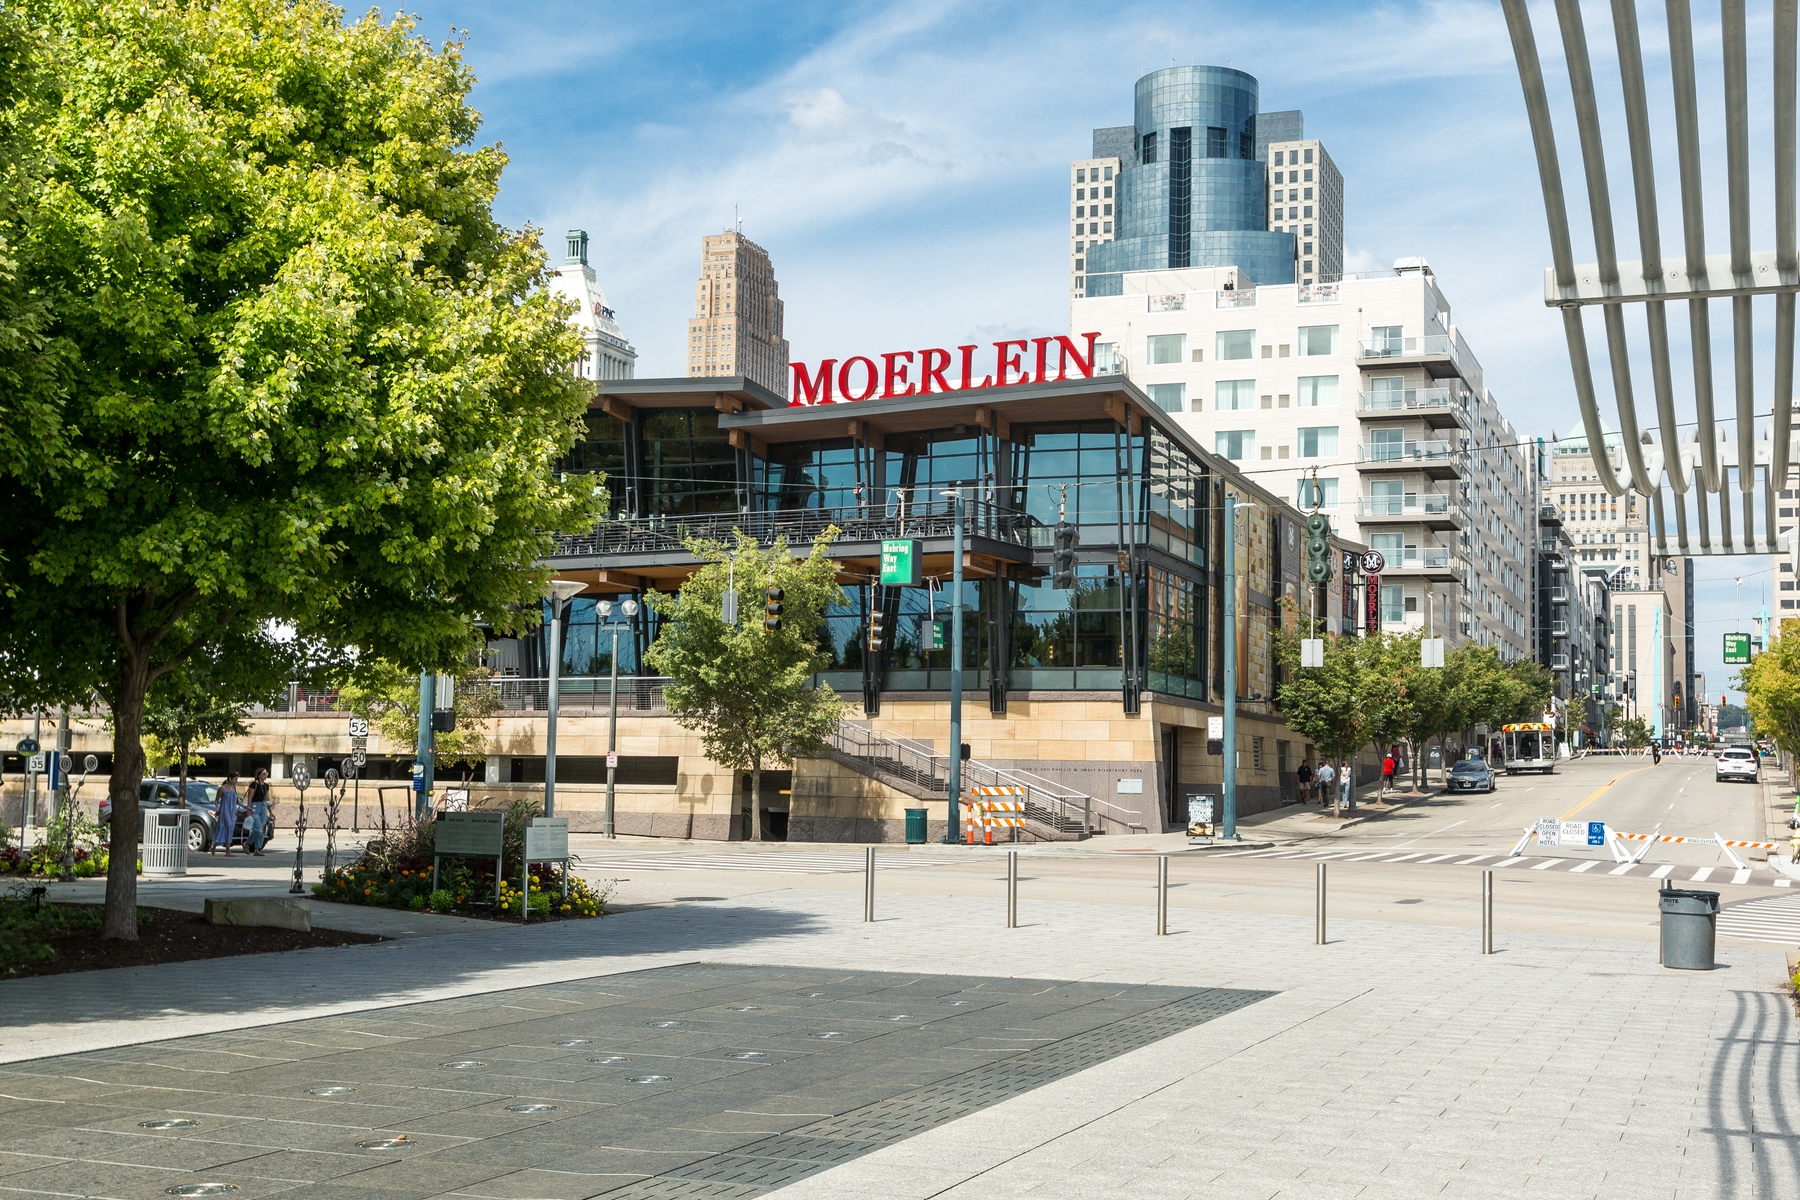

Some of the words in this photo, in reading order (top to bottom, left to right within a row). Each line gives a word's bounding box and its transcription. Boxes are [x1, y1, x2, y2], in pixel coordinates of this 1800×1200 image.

[602, 305, 615, 319] PNC
[787, 331, 1101, 408] MOERLEIN
[883, 543, 908, 554] Mehring
[883, 553, 897, 565] Way
[1364, 554, 1379, 569] M
[882, 563, 896, 572] East
[1367, 575, 1378, 636] MOERLEI
[1725, 634, 1746, 642] Mehring
[352, 722, 366, 732] 52
[353, 752, 365, 763] 50
[31, 760, 43, 769] 35
